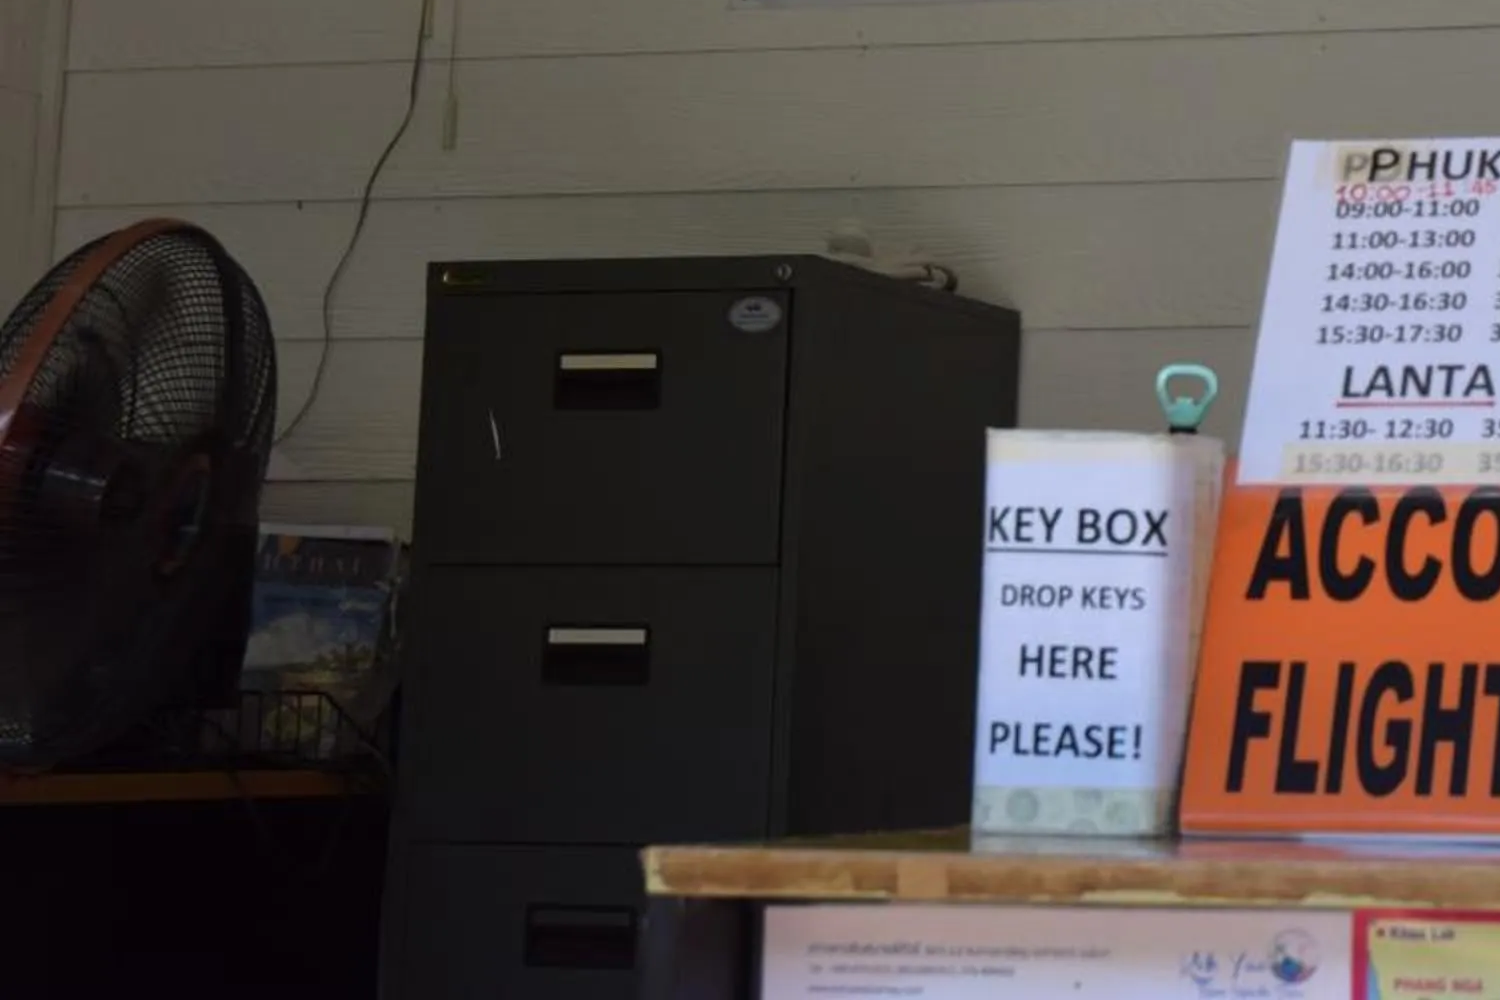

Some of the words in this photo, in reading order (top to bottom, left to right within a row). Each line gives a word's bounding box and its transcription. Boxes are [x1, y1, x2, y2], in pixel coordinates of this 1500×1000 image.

[1335, 199, 1481, 219] 09:00-11:00
[1332, 230, 1477, 250] 11:00-13:00
[1327, 261, 1472, 281] 14:00-16:00
[1321, 292, 1468, 312] 14:30-16:30
[1316, 324, 1464, 344] 15:30-17:30
[1341, 363, 1497, 399] LANTA
[1383, 418, 1455, 439] 12:30
[1293, 452, 1446, 475] 15:30-16:30
[987, 506, 1063, 545] KEY
[1076, 507, 1171, 548] BOX
[999, 583, 1073, 609] DROP
[1081, 585, 1147, 611] KEYS
[1018, 644, 1119, 680] HERE
[988, 721, 1143, 761] PLEASE!
